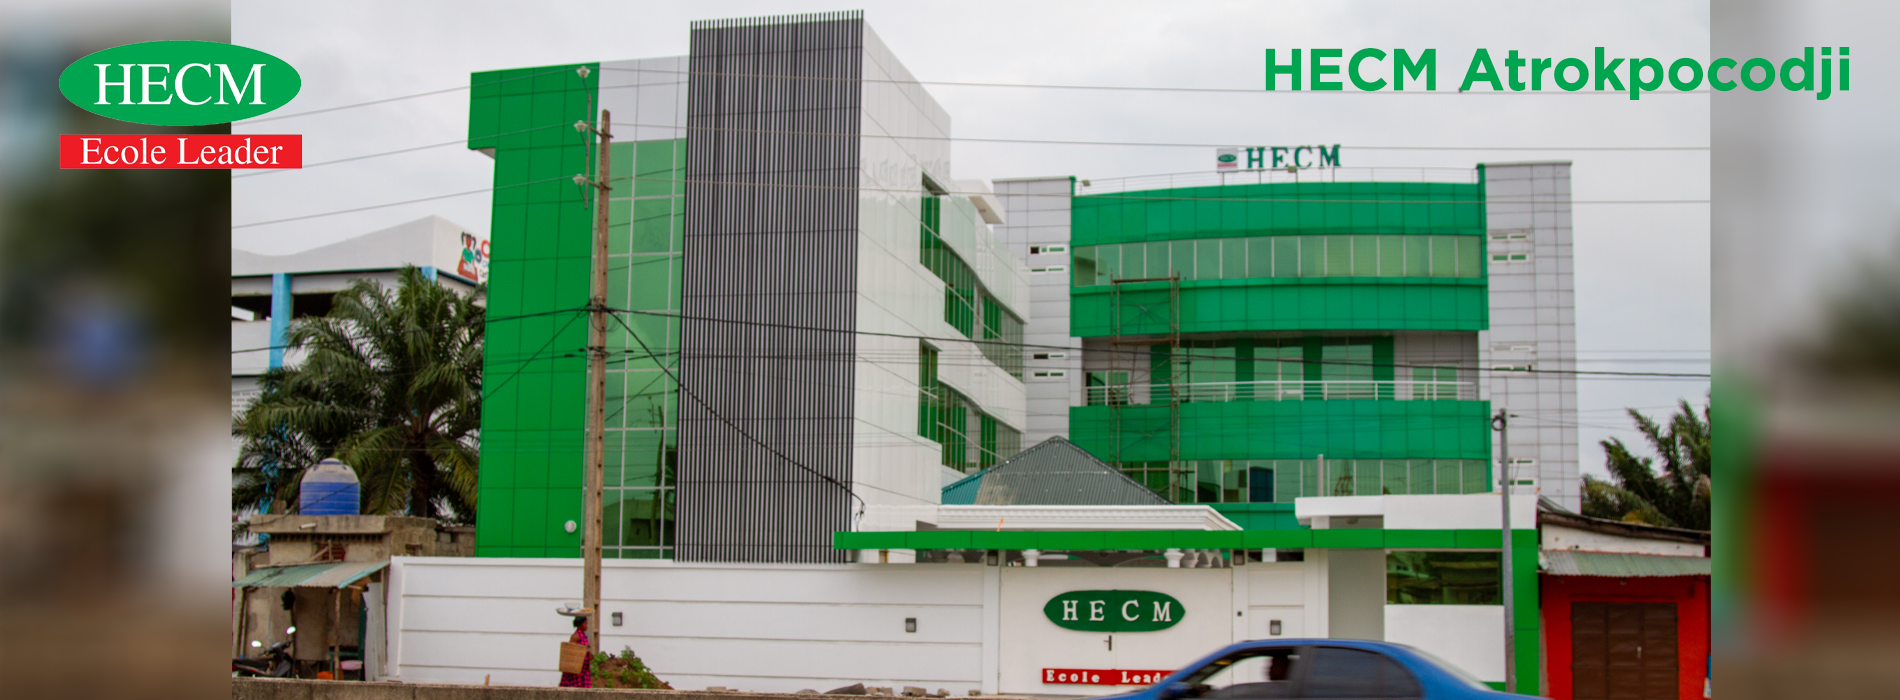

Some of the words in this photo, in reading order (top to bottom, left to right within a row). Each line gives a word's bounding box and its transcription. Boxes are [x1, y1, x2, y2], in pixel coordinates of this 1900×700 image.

[1246, 144, 1341, 171] HECM
[1062, 600, 1172, 622] HECM
[1046, 669, 1100, 683] Ecole
[1121, 671, 1169, 684] Lead
